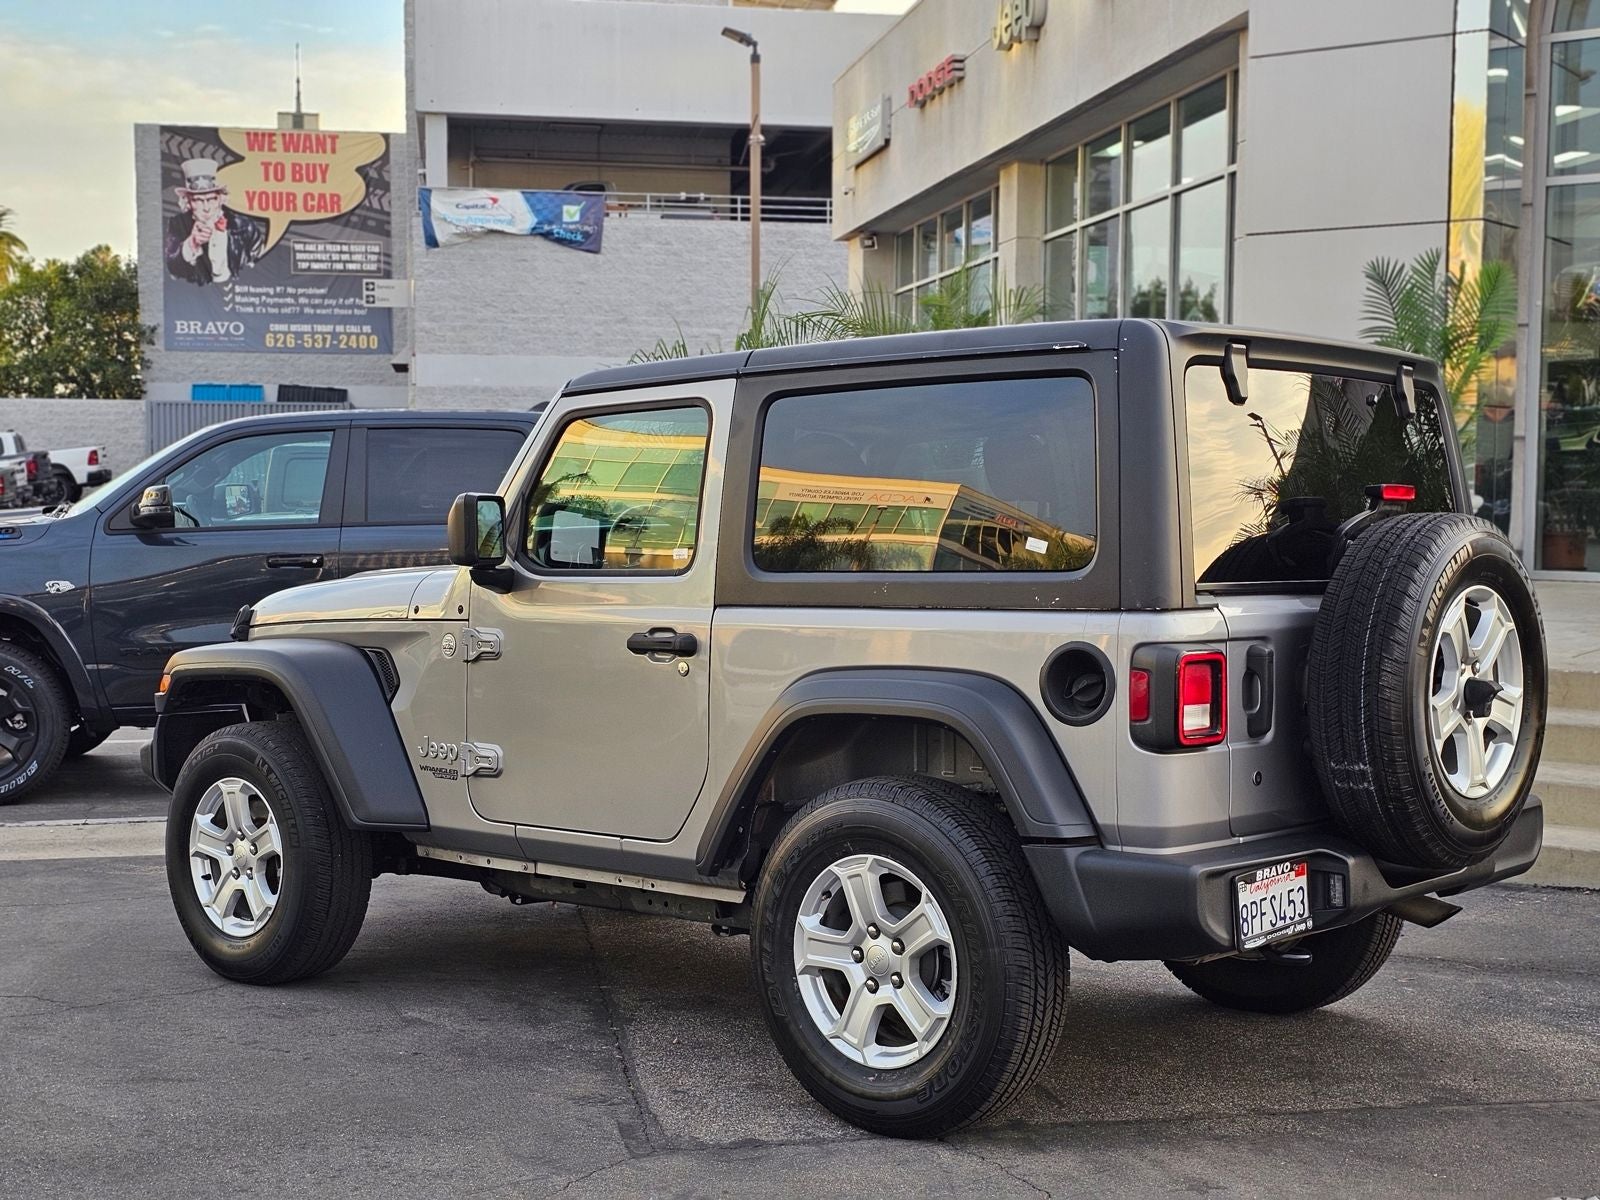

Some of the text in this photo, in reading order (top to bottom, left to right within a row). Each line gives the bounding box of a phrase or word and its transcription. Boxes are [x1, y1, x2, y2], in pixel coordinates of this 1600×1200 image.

[908, 54, 958, 108] DODGE
[245, 131, 339, 155] WE WANT
[260, 161, 330, 184] TO BUY
[245, 190, 342, 213] YOUR CAR
[235, 295, 260, 304] Making
[324, 298, 337, 306] pay
[344, 297, 354, 305] off
[286, 286, 297, 294] No
[297, 286, 329, 295] problem!
[235, 305, 254, 313] Think
[175, 320, 244, 335] BRAVO
[265, 333, 379, 349] 626-537-2400
[1425, 543, 1470, 624] MICHELIN
[418, 736, 458, 765] Jeep
[419, 764, 458, 775] WRANGLER
[433, 772, 458, 780] SPORT
[1256, 862, 1291, 882] BRAVO
[1241, 885, 1306, 937] 8PFS453
